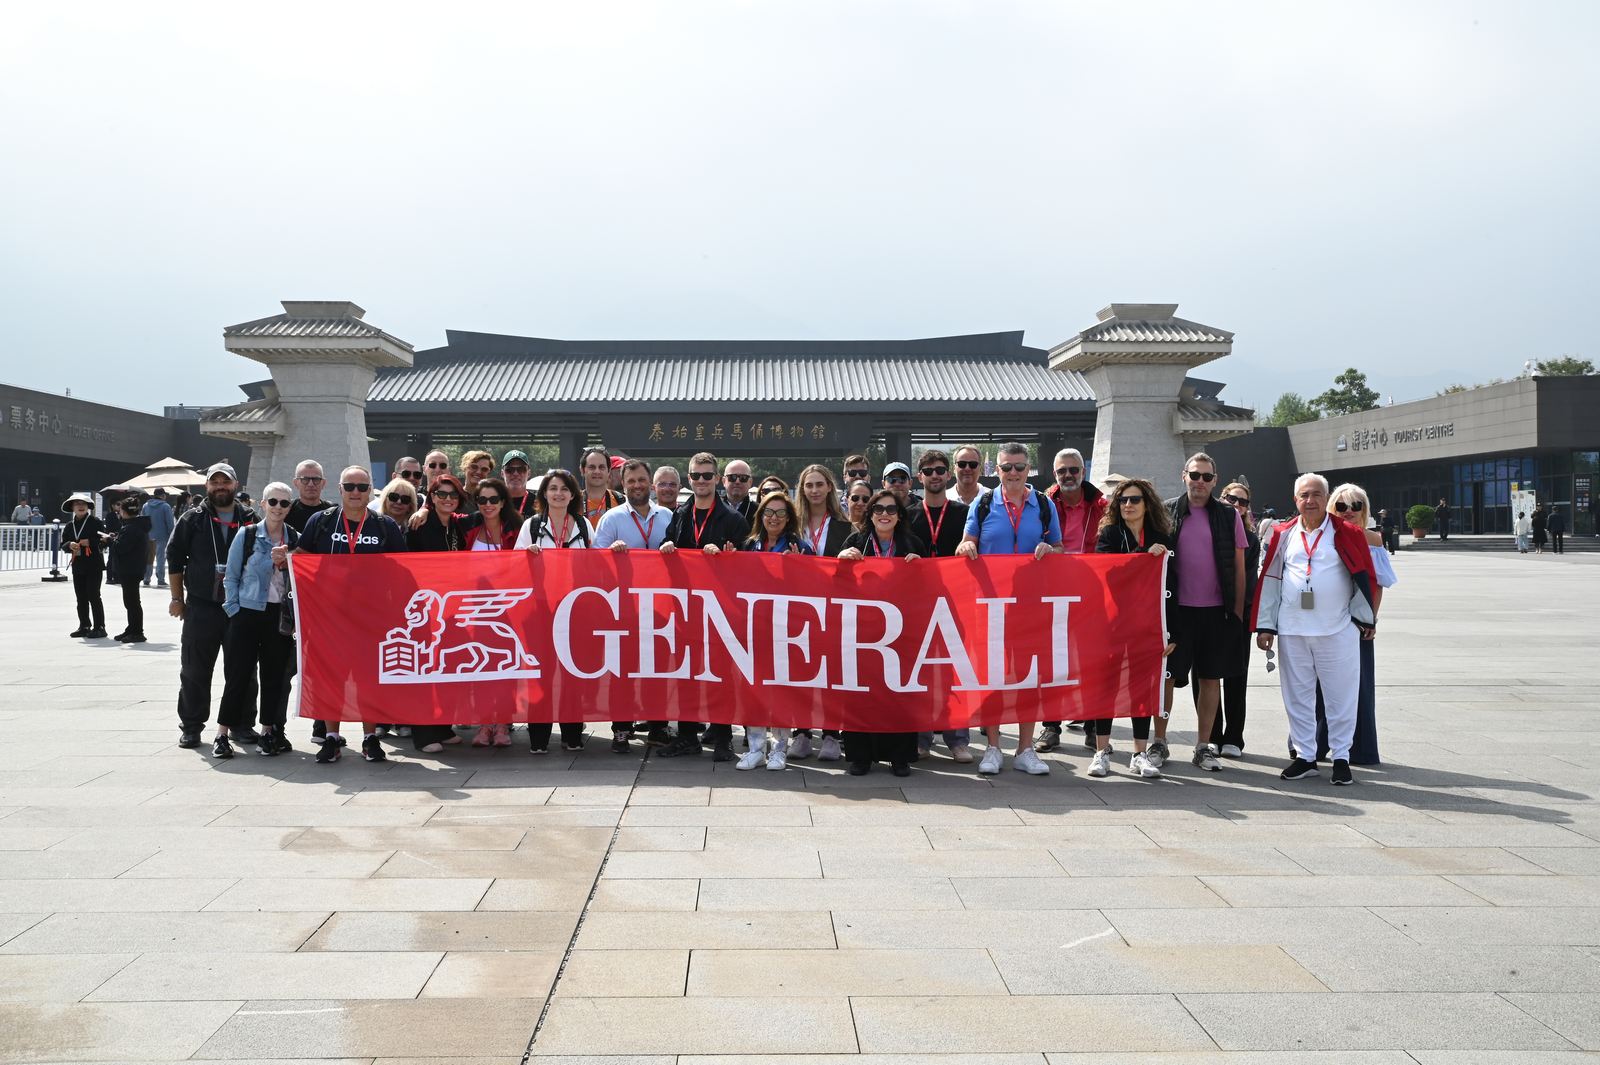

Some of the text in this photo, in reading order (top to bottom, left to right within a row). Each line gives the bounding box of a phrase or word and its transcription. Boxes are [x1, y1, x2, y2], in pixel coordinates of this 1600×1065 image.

[10, 405, 62, 434] 票务中心
[1394, 422, 1455, 444] TOURIST CENTRE
[552, 586, 1082, 692] GENERALI
